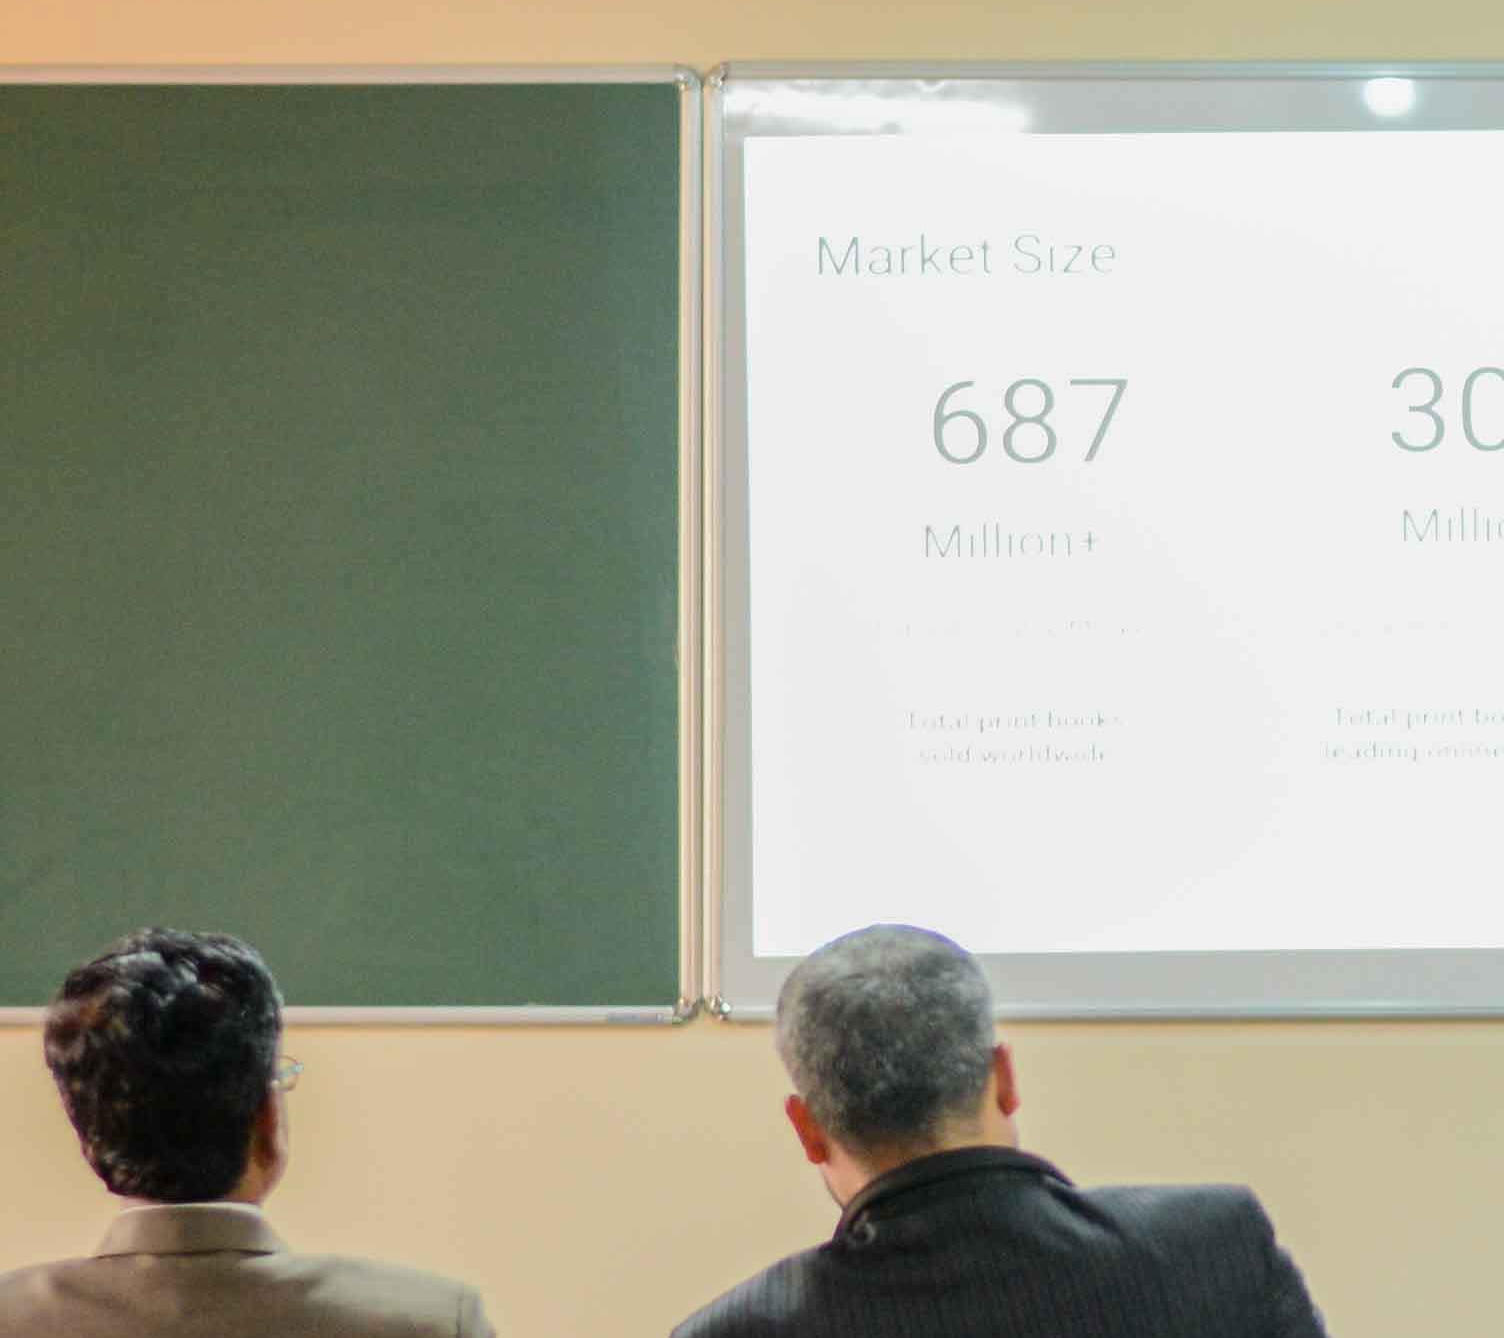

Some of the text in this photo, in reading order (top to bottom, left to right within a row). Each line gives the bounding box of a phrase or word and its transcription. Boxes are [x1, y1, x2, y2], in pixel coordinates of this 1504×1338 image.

[817, 233, 1116, 275] Market Size
[932, 377, 1128, 465] 687
[923, 521, 1099, 559] Million+
